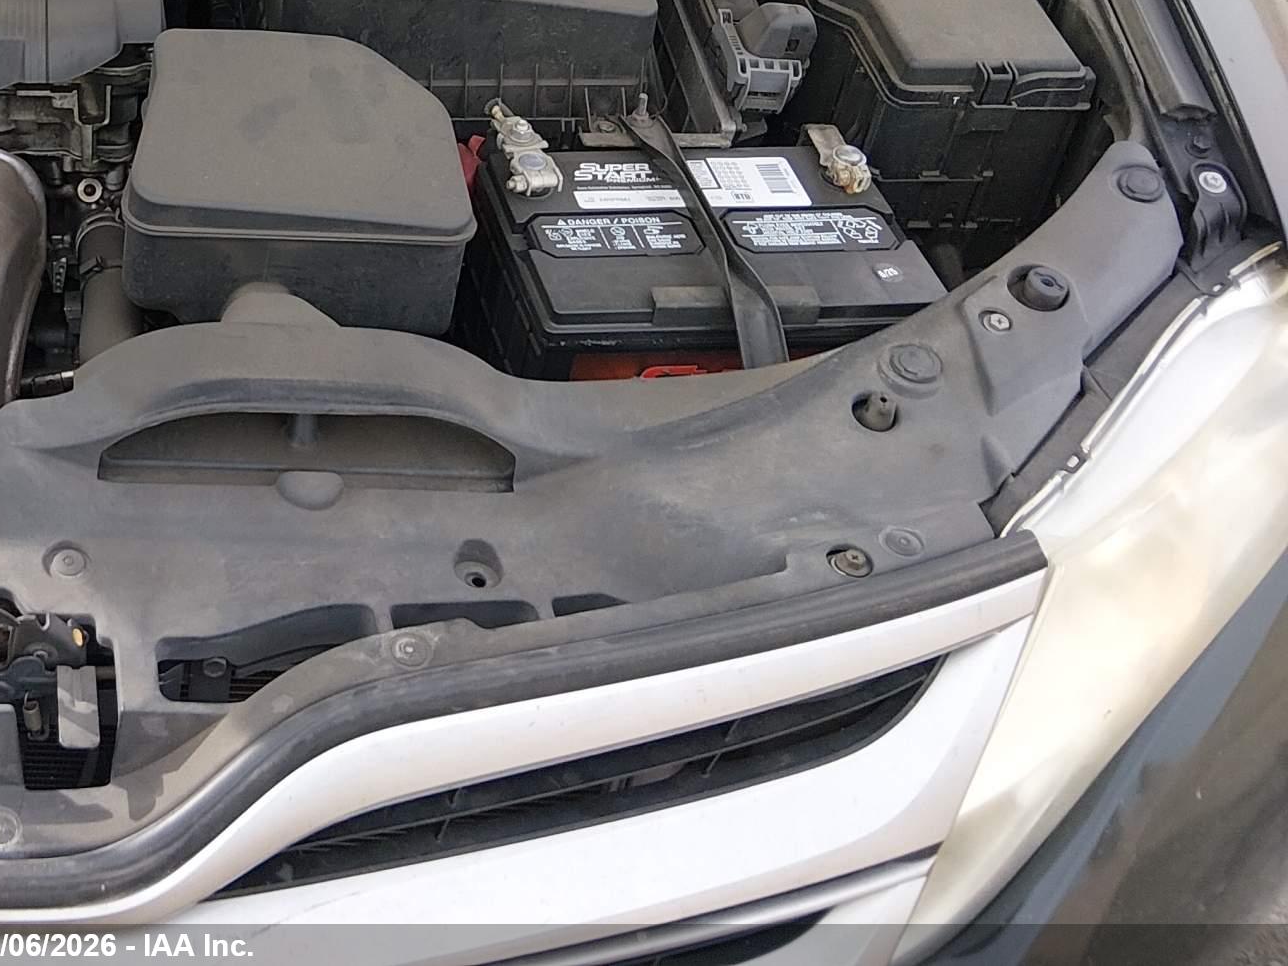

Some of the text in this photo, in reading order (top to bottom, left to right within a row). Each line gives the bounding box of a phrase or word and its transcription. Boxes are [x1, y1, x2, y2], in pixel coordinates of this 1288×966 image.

[579, 162, 650, 172] SUPER
[573, 170, 653, 182] START
[567, 217, 611, 226] DANGER
[621, 216, 661, 225] POISON
